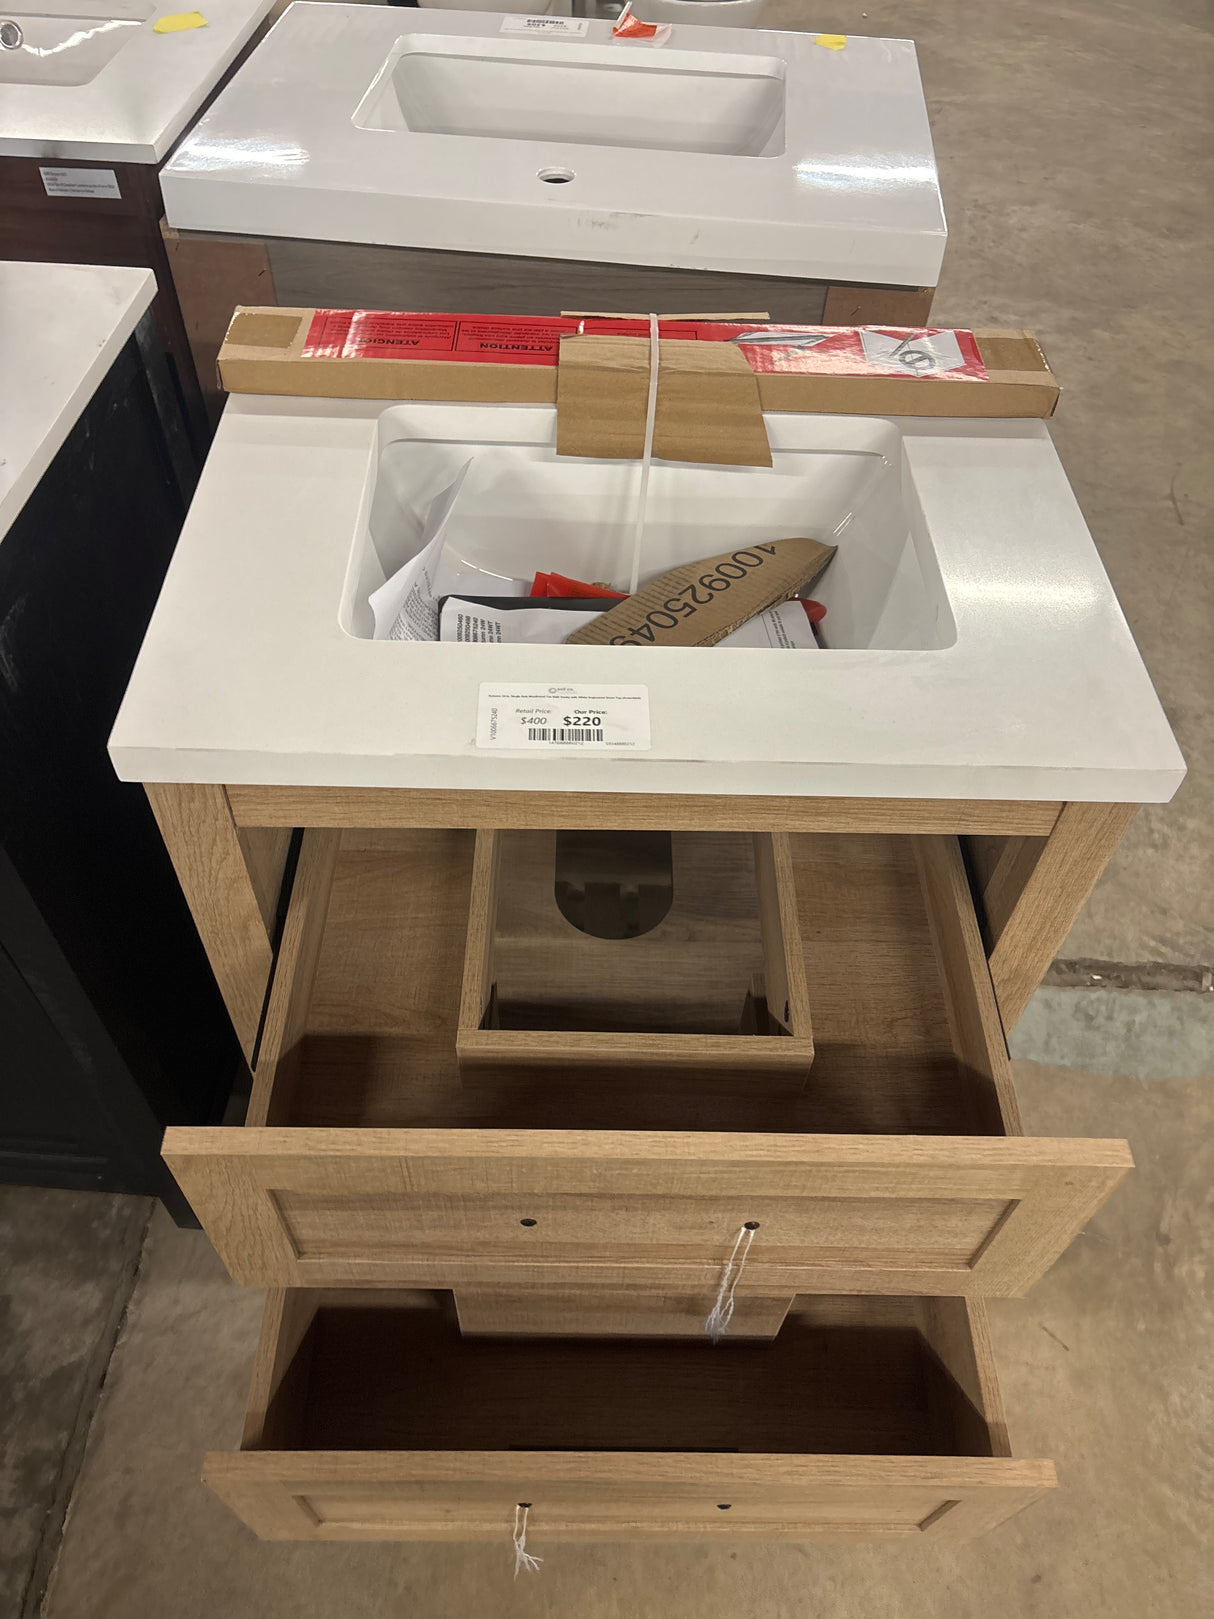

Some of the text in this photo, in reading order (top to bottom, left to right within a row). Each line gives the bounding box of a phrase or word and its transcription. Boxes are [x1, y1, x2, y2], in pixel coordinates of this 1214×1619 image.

[480, 343, 553, 352] ATTENTION
[520, 717, 547, 725] $400
[563, 716, 601, 727] $220
